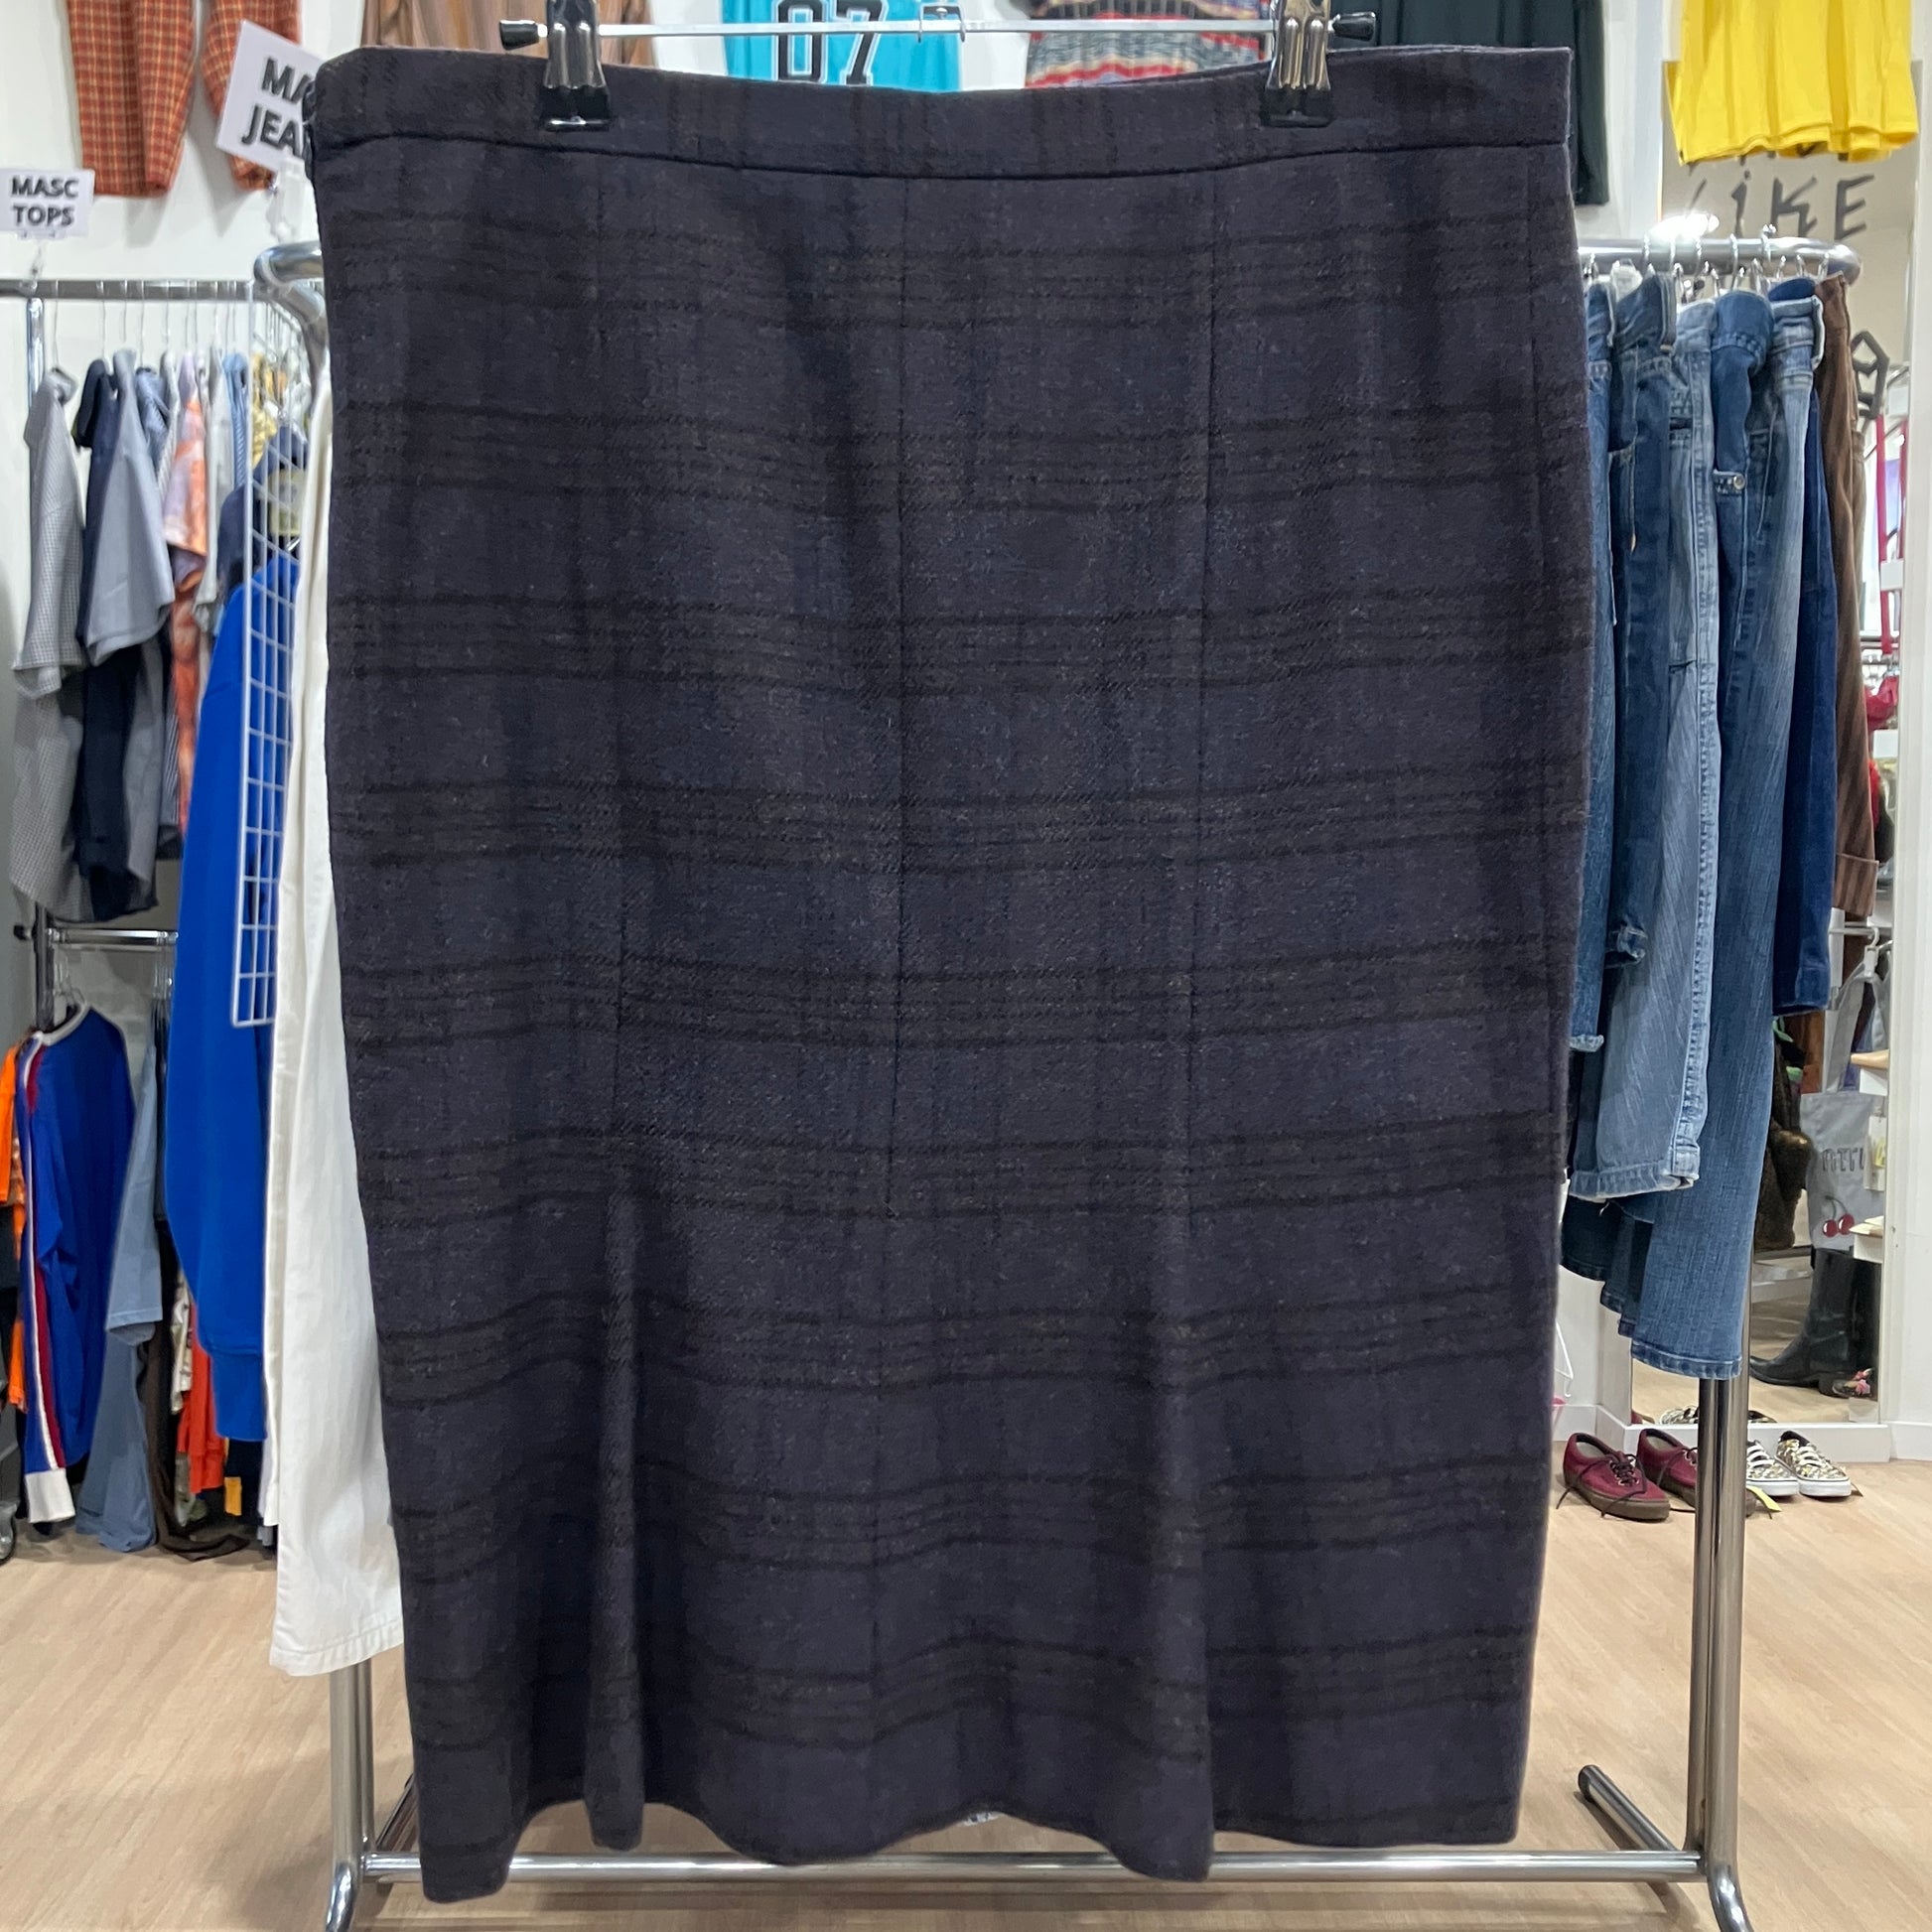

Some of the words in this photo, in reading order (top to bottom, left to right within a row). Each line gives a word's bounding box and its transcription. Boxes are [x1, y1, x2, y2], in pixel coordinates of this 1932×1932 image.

[771, 0, 889, 85] 07
[11, 175, 79, 199] MASC
[13, 205, 74, 227] TOPS
